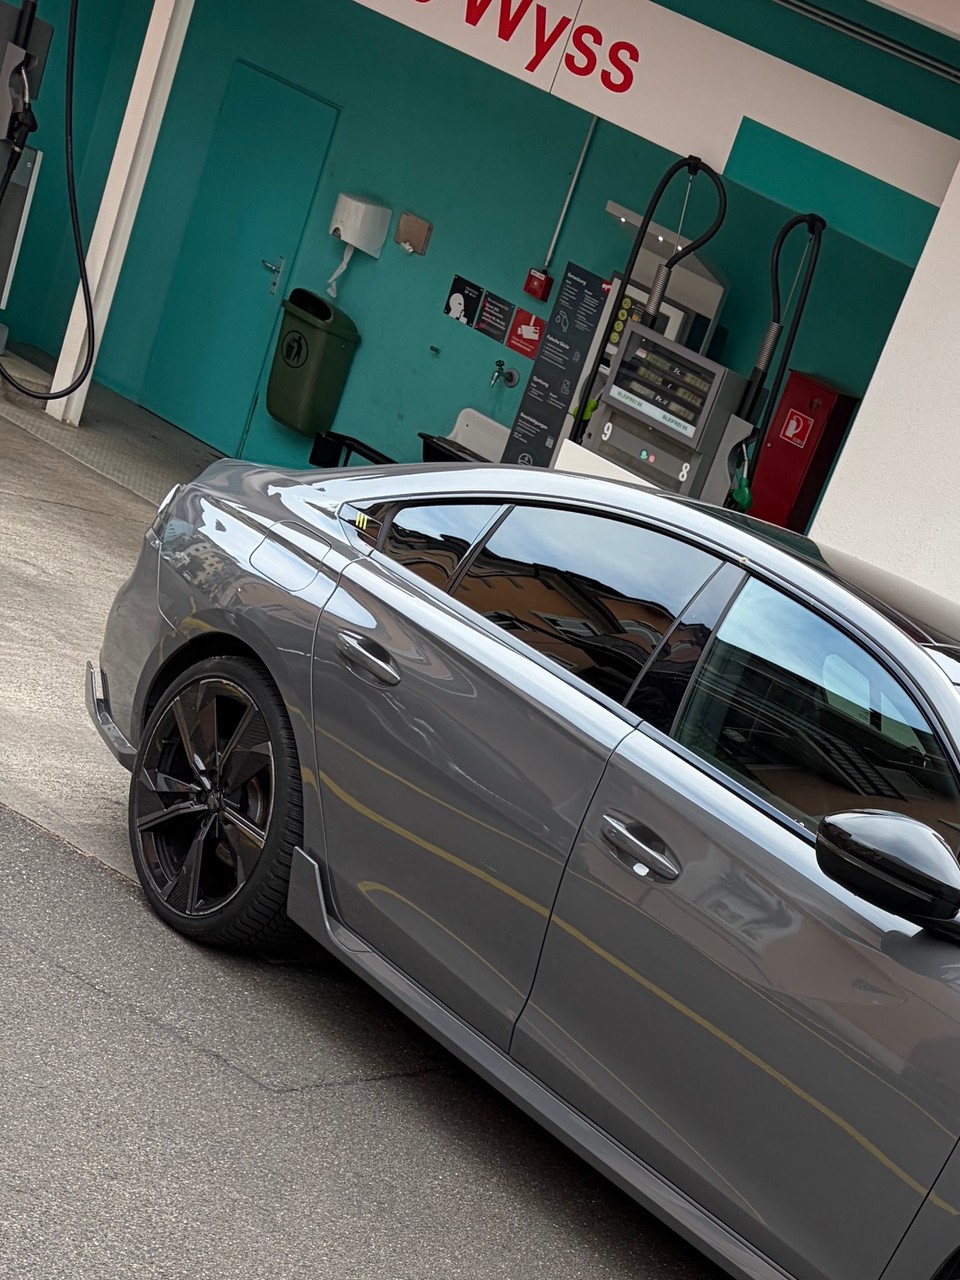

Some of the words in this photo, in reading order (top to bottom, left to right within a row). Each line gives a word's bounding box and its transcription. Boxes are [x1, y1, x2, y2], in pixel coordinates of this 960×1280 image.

[465, 0, 640, 93] Wyss
[601, 422, 613, 441] 9
[679, 463, 690, 482] 8
